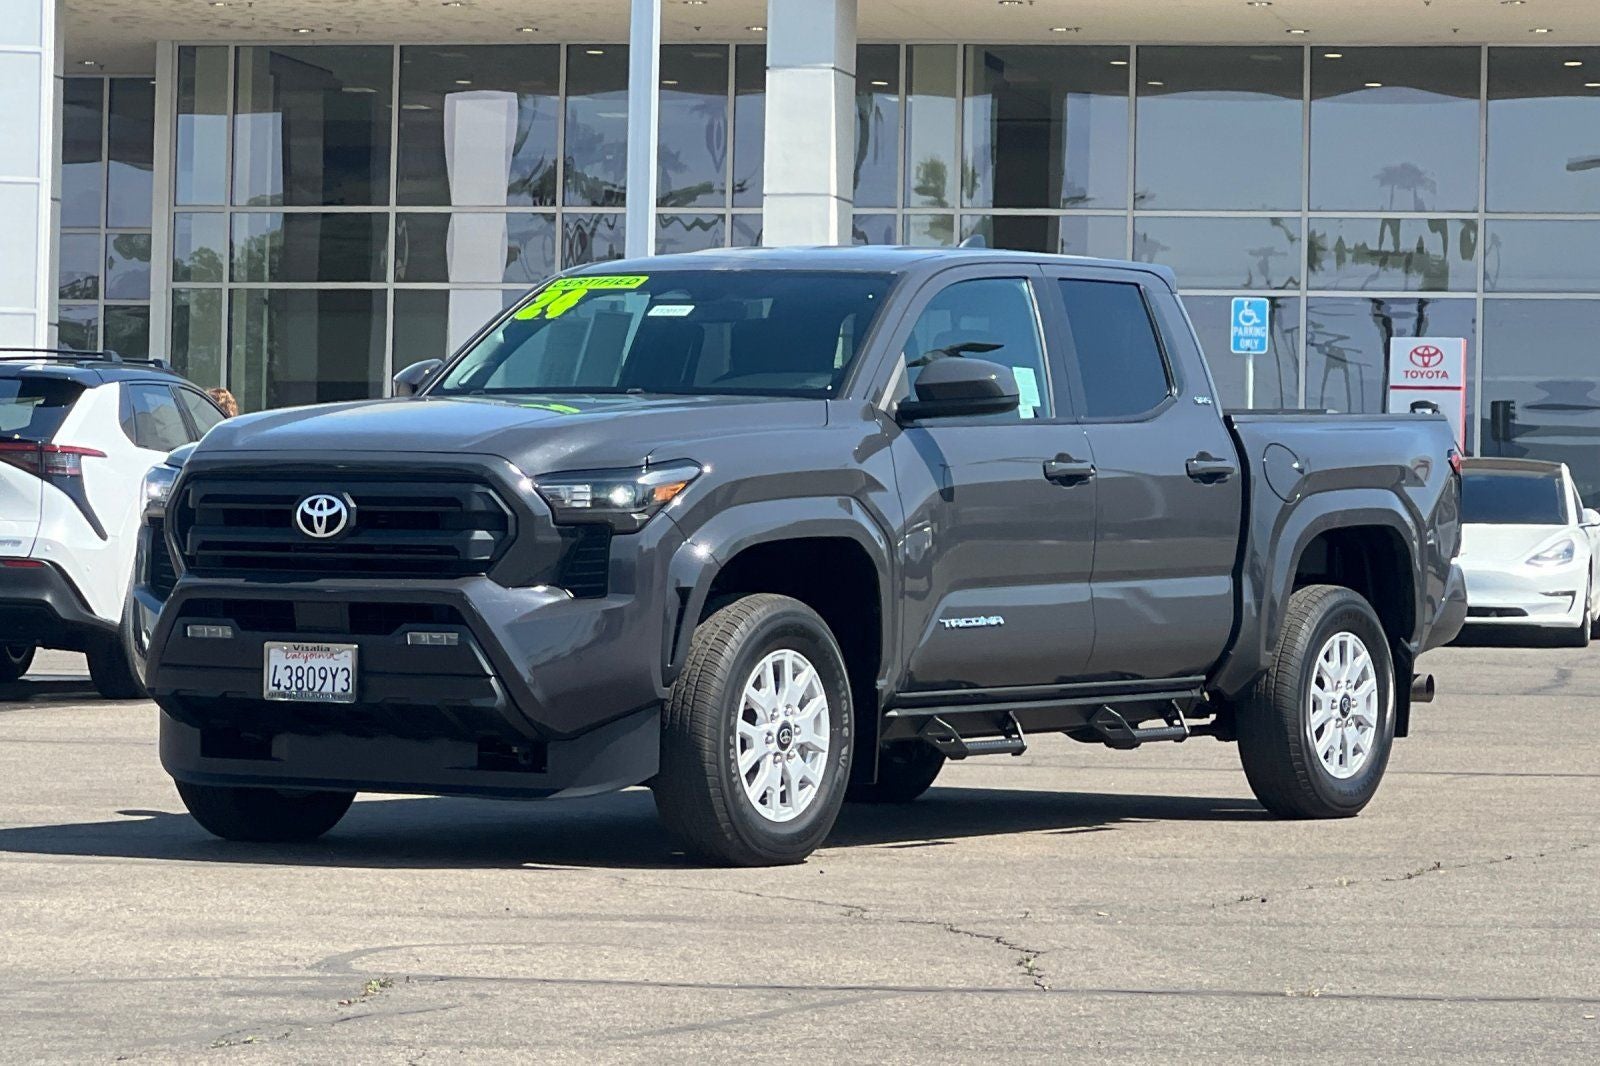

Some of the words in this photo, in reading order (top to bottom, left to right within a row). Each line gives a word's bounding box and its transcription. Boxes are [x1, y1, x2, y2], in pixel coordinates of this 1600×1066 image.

[550, 278, 642, 290] CERTIFIED
[1233, 325, 1266, 337] PARKING
[1239, 338, 1259, 349] ONLY
[1403, 369, 1449, 379] TOYOTA
[938, 615, 1005, 628] TACOMA
[292, 644, 330, 652] Visalia
[271, 664, 351, 693] 43809Y3
